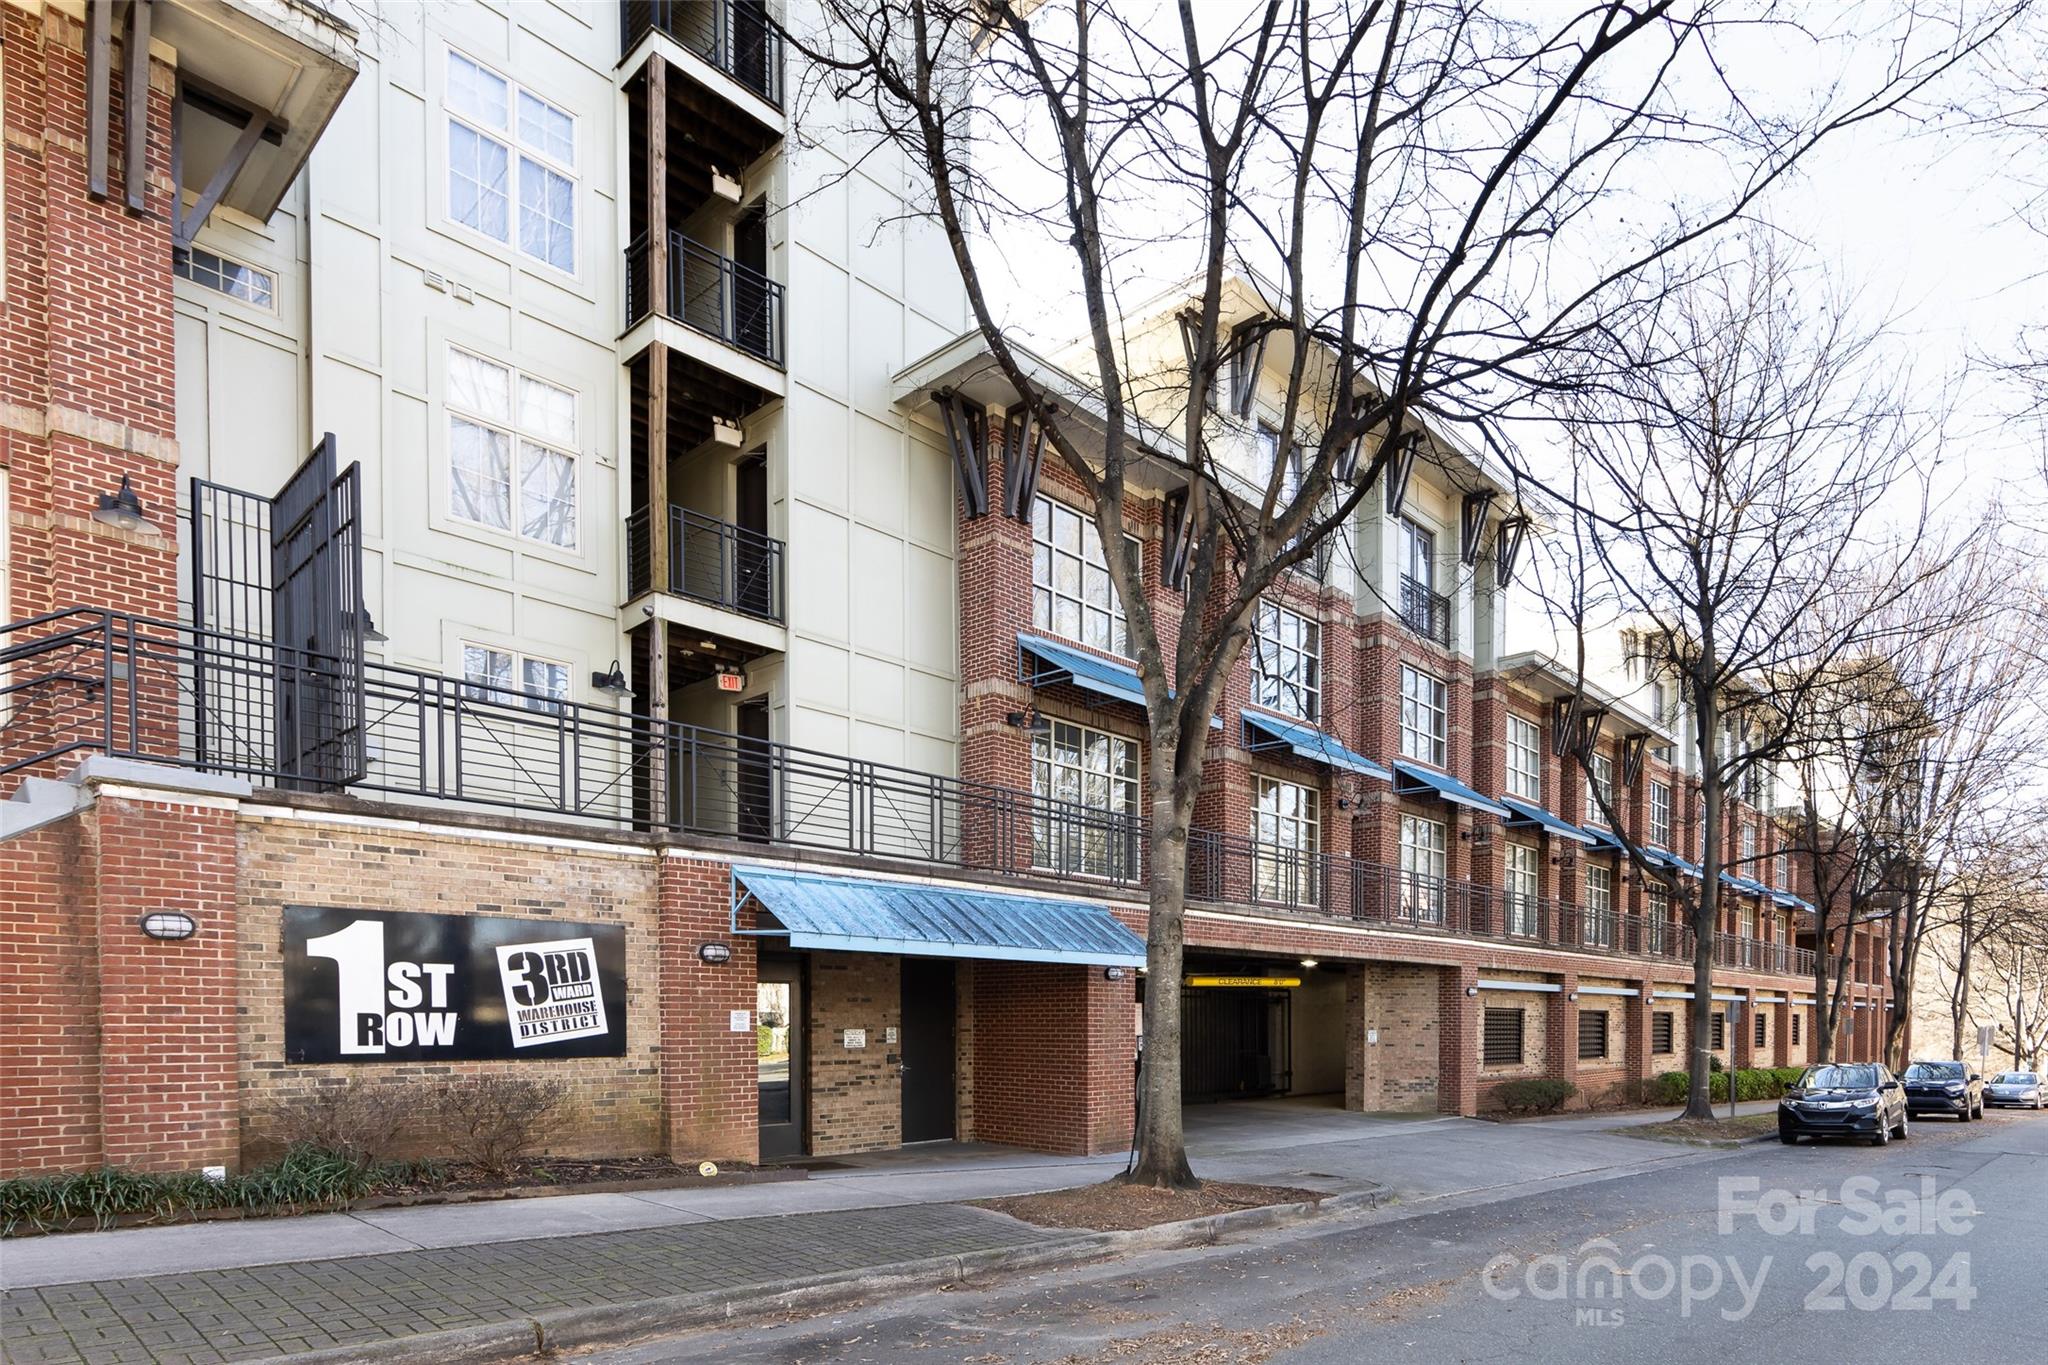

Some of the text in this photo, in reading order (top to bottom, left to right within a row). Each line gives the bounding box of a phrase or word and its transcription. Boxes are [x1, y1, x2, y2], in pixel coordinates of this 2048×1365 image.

[722, 675, 738, 689] EXIT
[507, 951, 591, 1007] 3RD
[552, 984, 593, 1001] WARD
[517, 1000, 597, 1022] WAREHOUSE
[357, 1012, 458, 1047] ROW
[520, 1014, 598, 1036] DISTRICT
